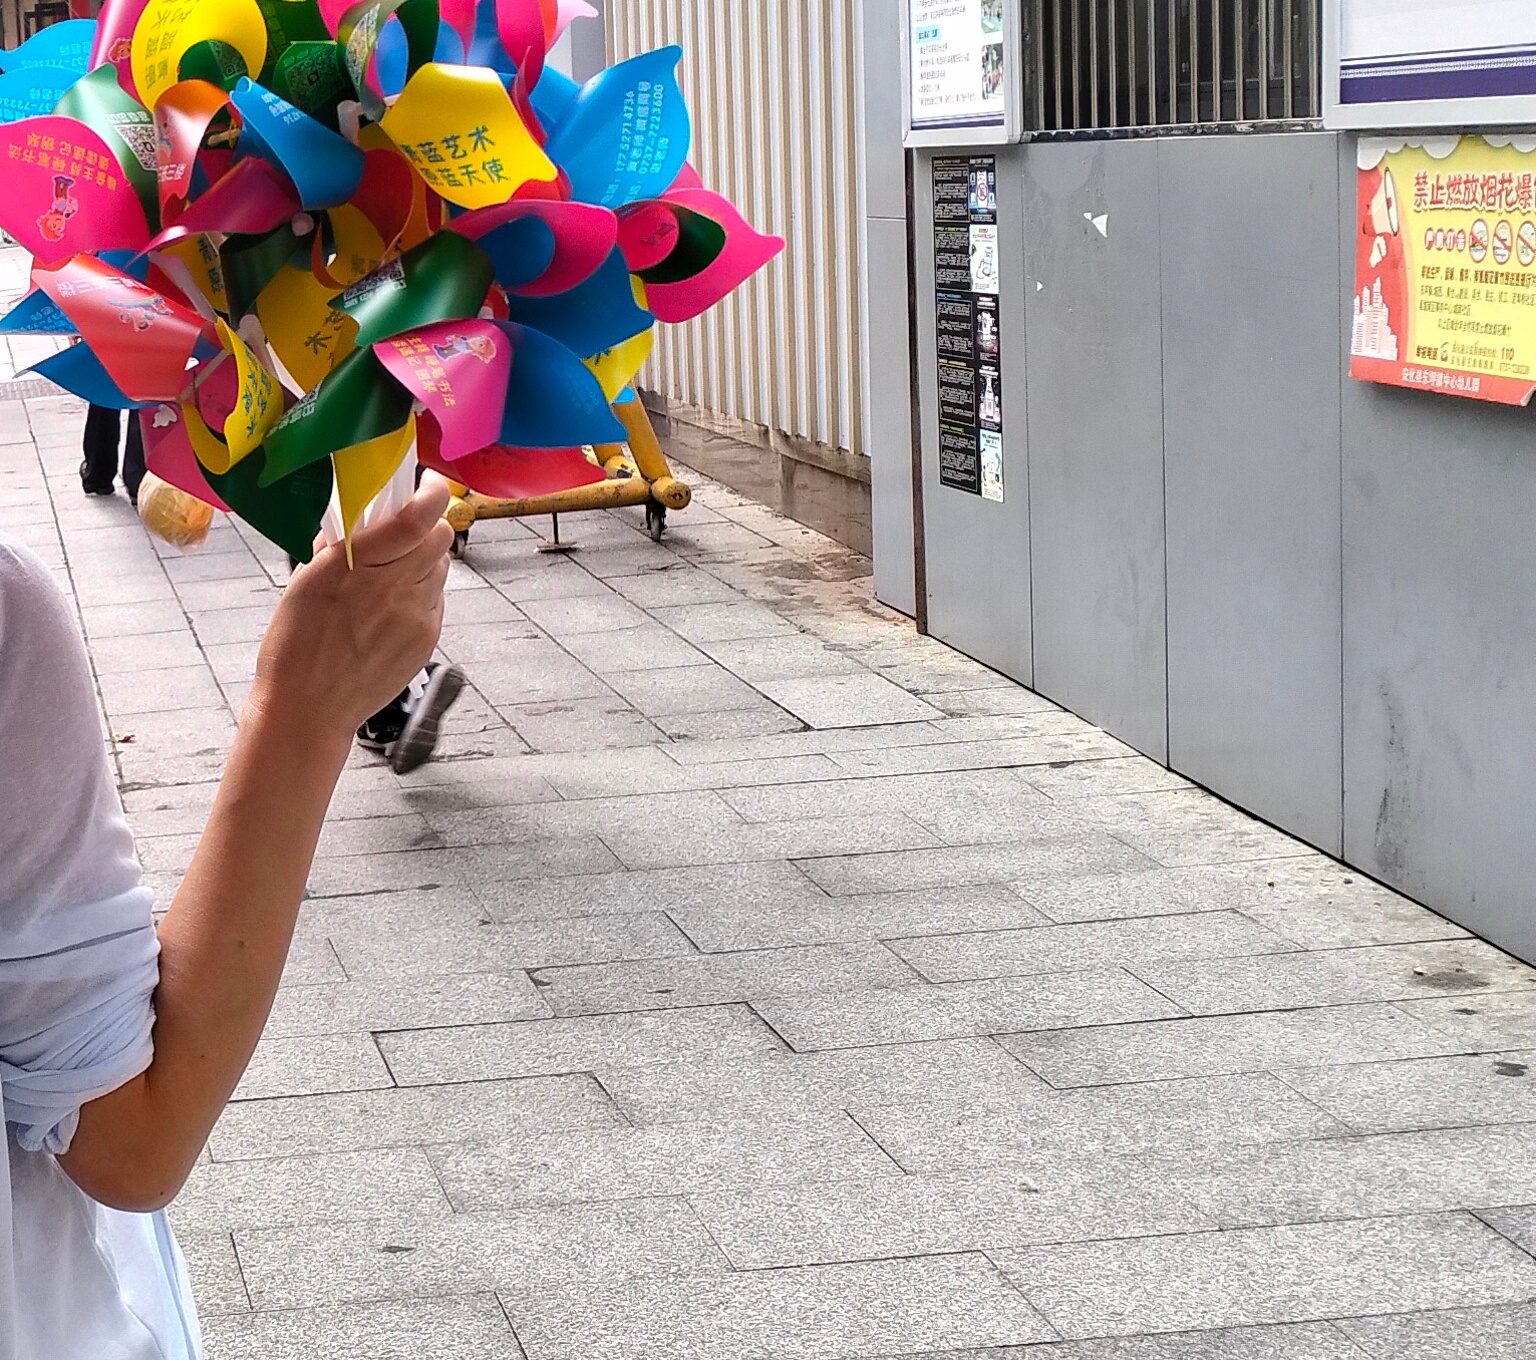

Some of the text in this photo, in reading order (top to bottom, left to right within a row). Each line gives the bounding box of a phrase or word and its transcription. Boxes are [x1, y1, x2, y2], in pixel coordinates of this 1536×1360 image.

[1414, 172, 1536, 212] 禁止燃放烟花爆
